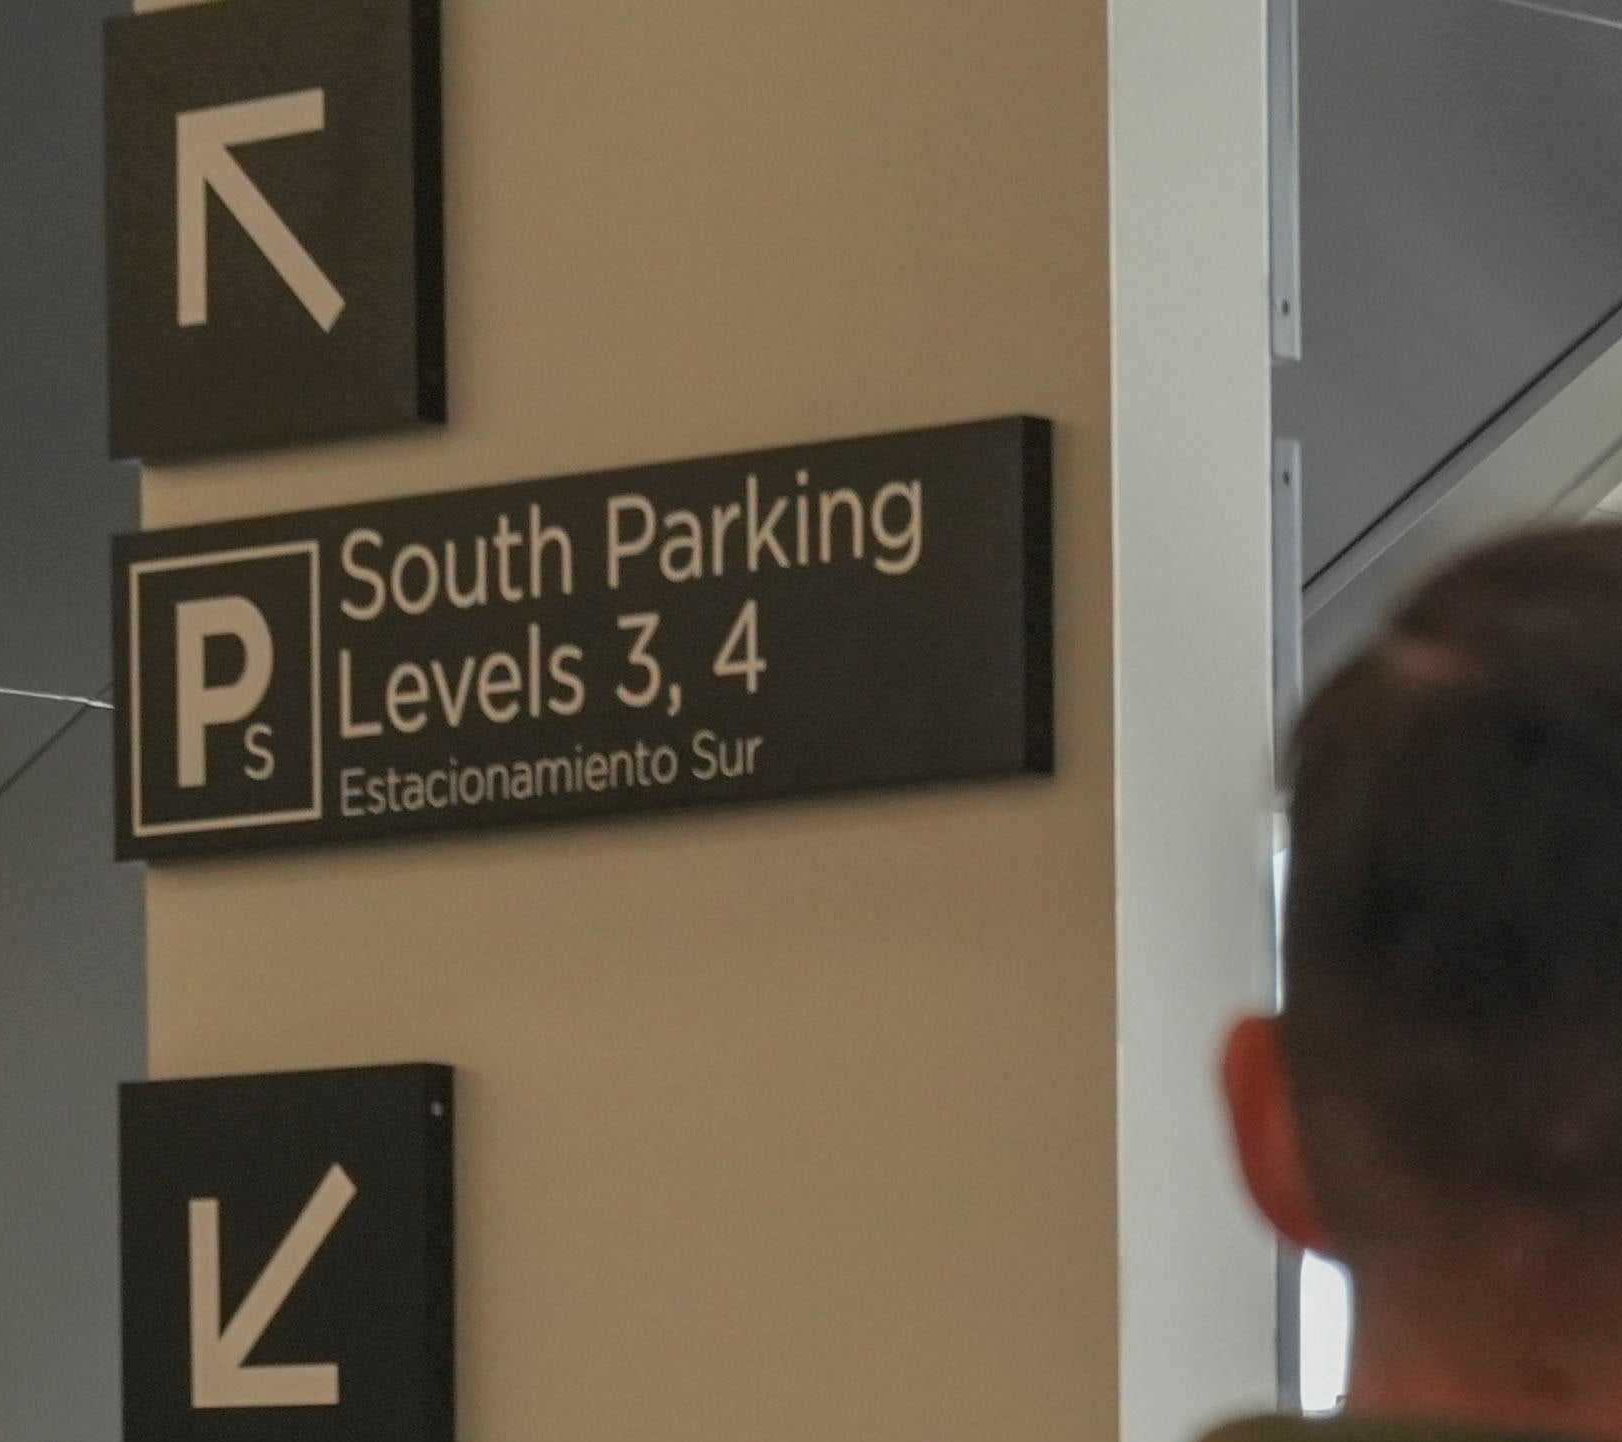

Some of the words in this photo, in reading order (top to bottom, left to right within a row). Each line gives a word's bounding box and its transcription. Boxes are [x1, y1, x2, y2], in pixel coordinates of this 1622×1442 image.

[339, 502, 573, 622] South
[607, 469, 924, 588] Parking
[338, 622, 585, 741] Levels
[615, 611, 684, 715] 3,
[712, 598, 767, 696] 4
[339, 740, 678, 818] Estacionamiento
[691, 730, 764, 781] Sur
